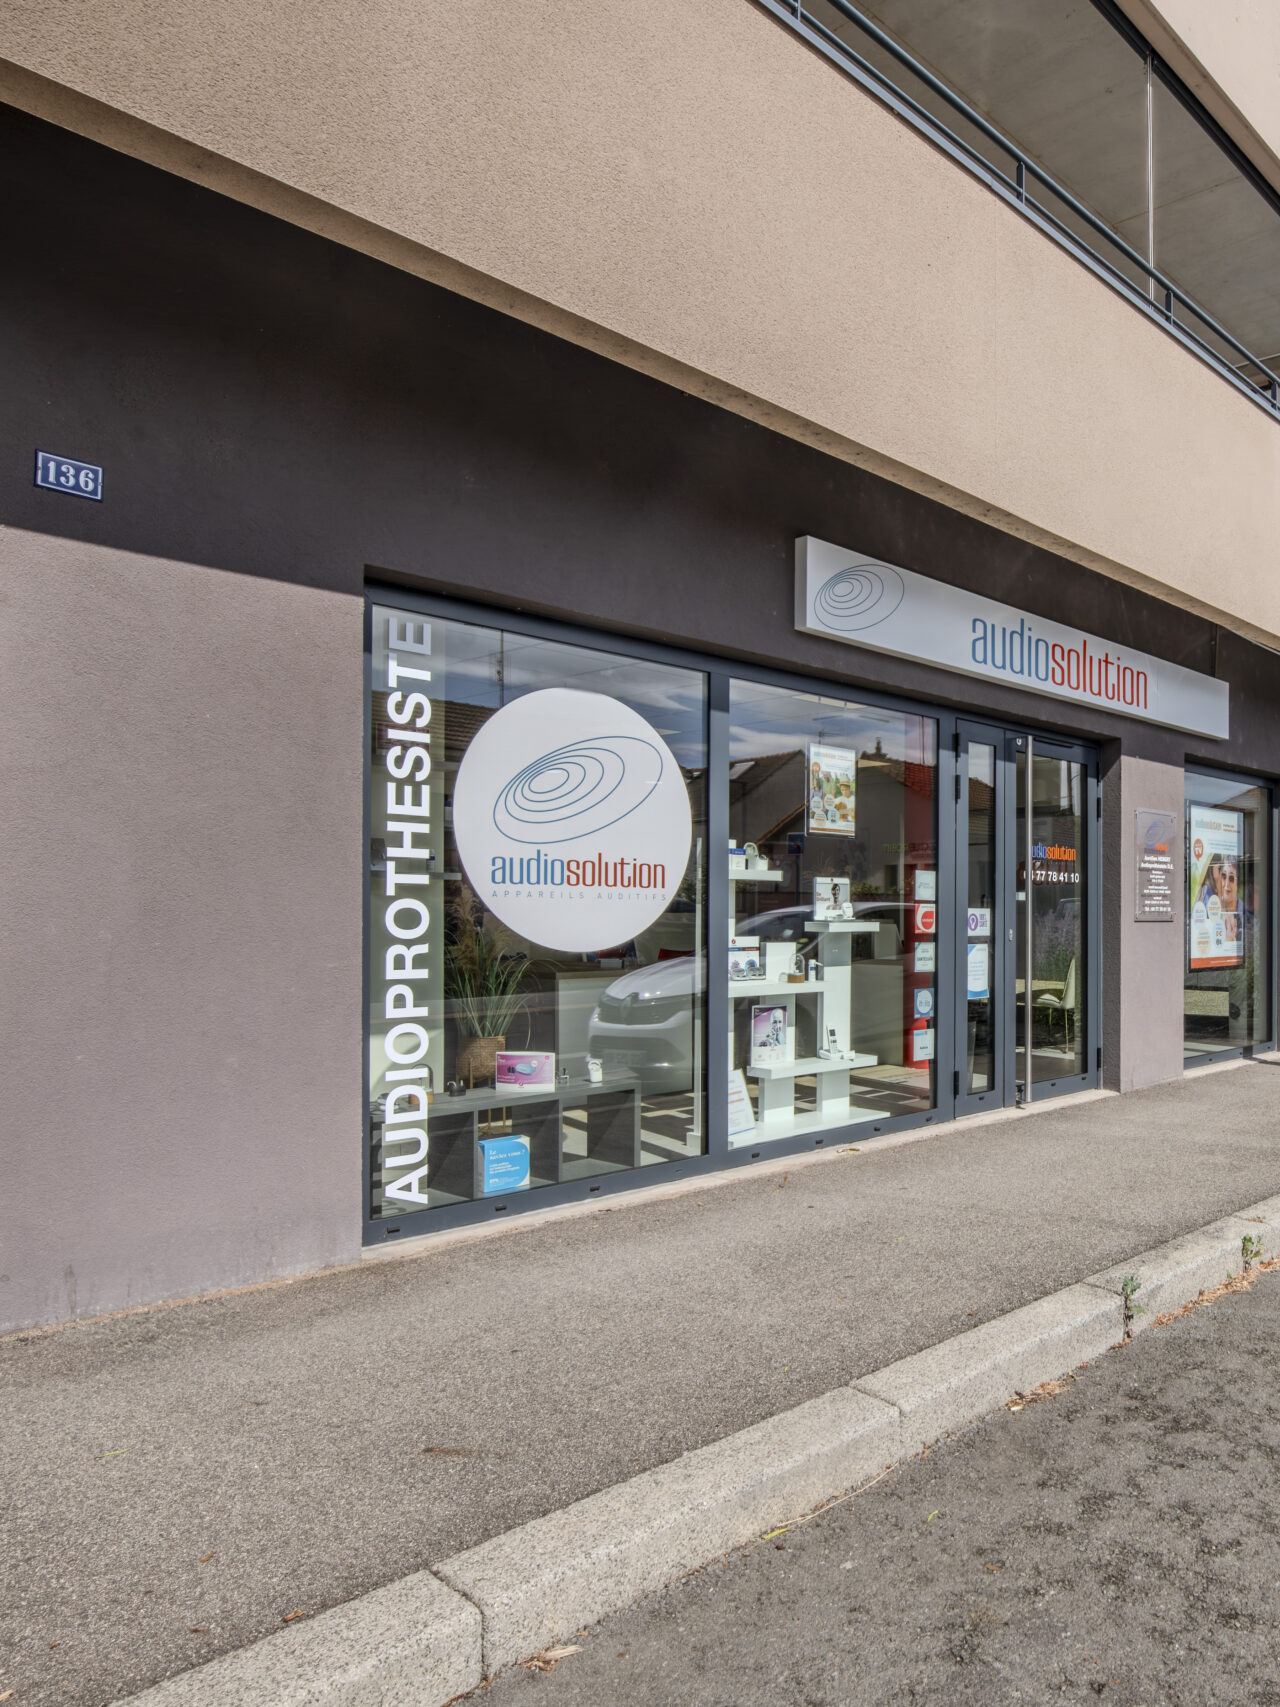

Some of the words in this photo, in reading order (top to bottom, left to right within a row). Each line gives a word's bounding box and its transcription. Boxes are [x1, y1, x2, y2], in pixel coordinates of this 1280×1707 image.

[48, 461, 95, 492] 136
[971, 617, 1148, 710] audiosolution
[1031, 842, 1077, 861] udiosolution
[491, 849, 666, 889] audiosolution
[1036, 870, 1046, 881] 77
[1048, 871, 1058, 882] 78
[1059, 872, 1068, 883] 41
[1071, 872, 1080, 883] 10
[385, 616, 432, 1204] AUDIOPROTHESISTE
[492, 890, 585, 899] APPAREILS
[597, 892, 667, 902] AUDITIFS
